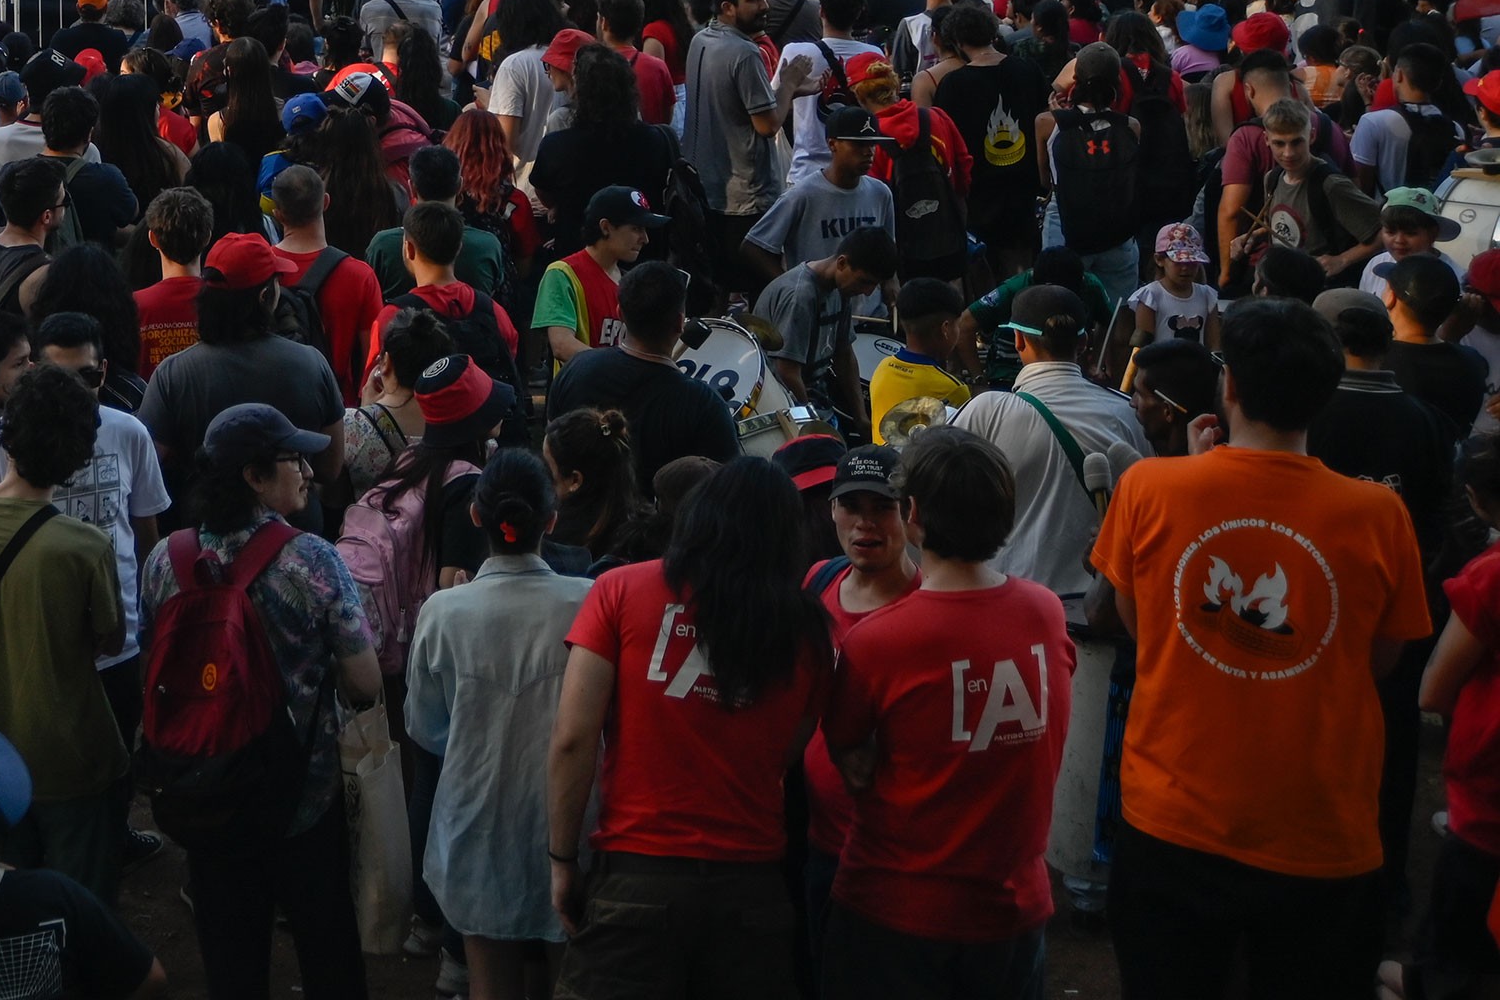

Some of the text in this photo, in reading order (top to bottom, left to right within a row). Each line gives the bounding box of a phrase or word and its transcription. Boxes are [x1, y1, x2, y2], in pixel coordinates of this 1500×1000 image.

[164, 321, 193, 329] NACIONAL
[1173, 587, 1181, 610] LOS
[1198, 526, 1220, 542] LOS
[1270, 521, 1293, 537] LOS
